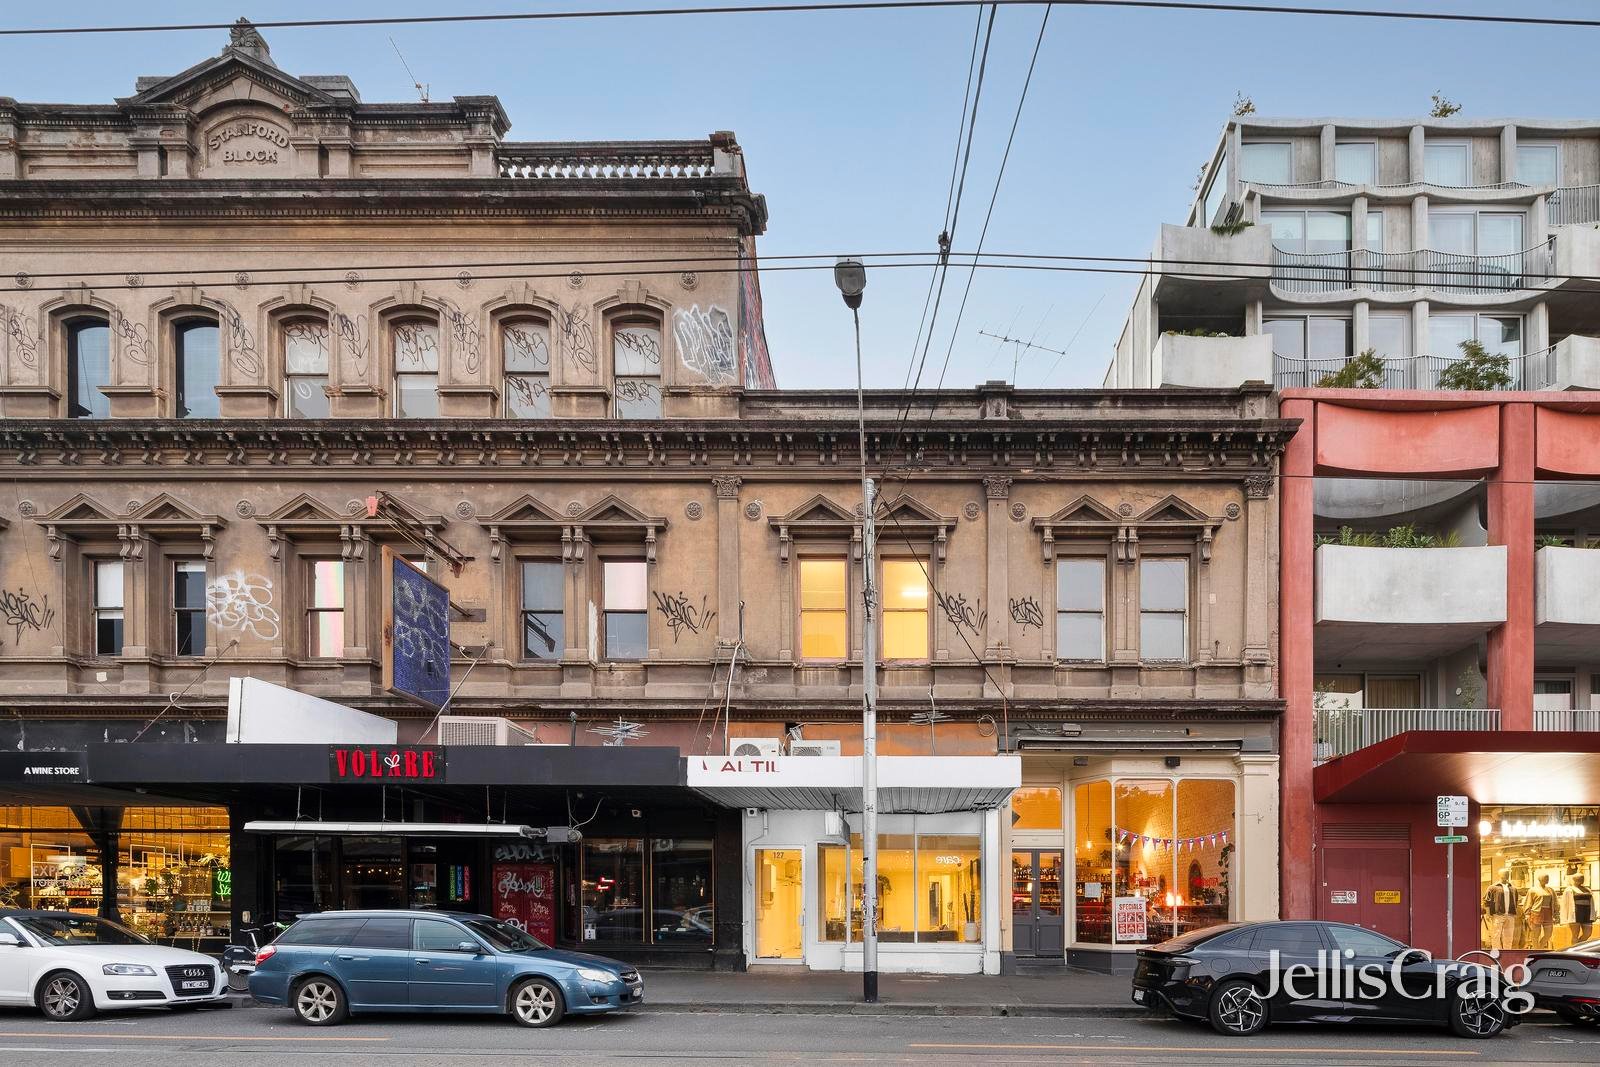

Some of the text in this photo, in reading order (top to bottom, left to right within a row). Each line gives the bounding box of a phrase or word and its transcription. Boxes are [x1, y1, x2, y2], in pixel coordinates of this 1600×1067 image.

[208, 123, 290, 149] STANFORD
[223, 149, 278, 163] BLOCK
[335, 748, 436, 778] VOLARE
[23, 766, 80, 775] A WINE STORE
[1438, 796, 1451, 805] 2P
[1438, 811, 1451, 820] 6P
[773, 851, 785, 859] 127
[1118, 903, 1143, 911] SPECIALS
